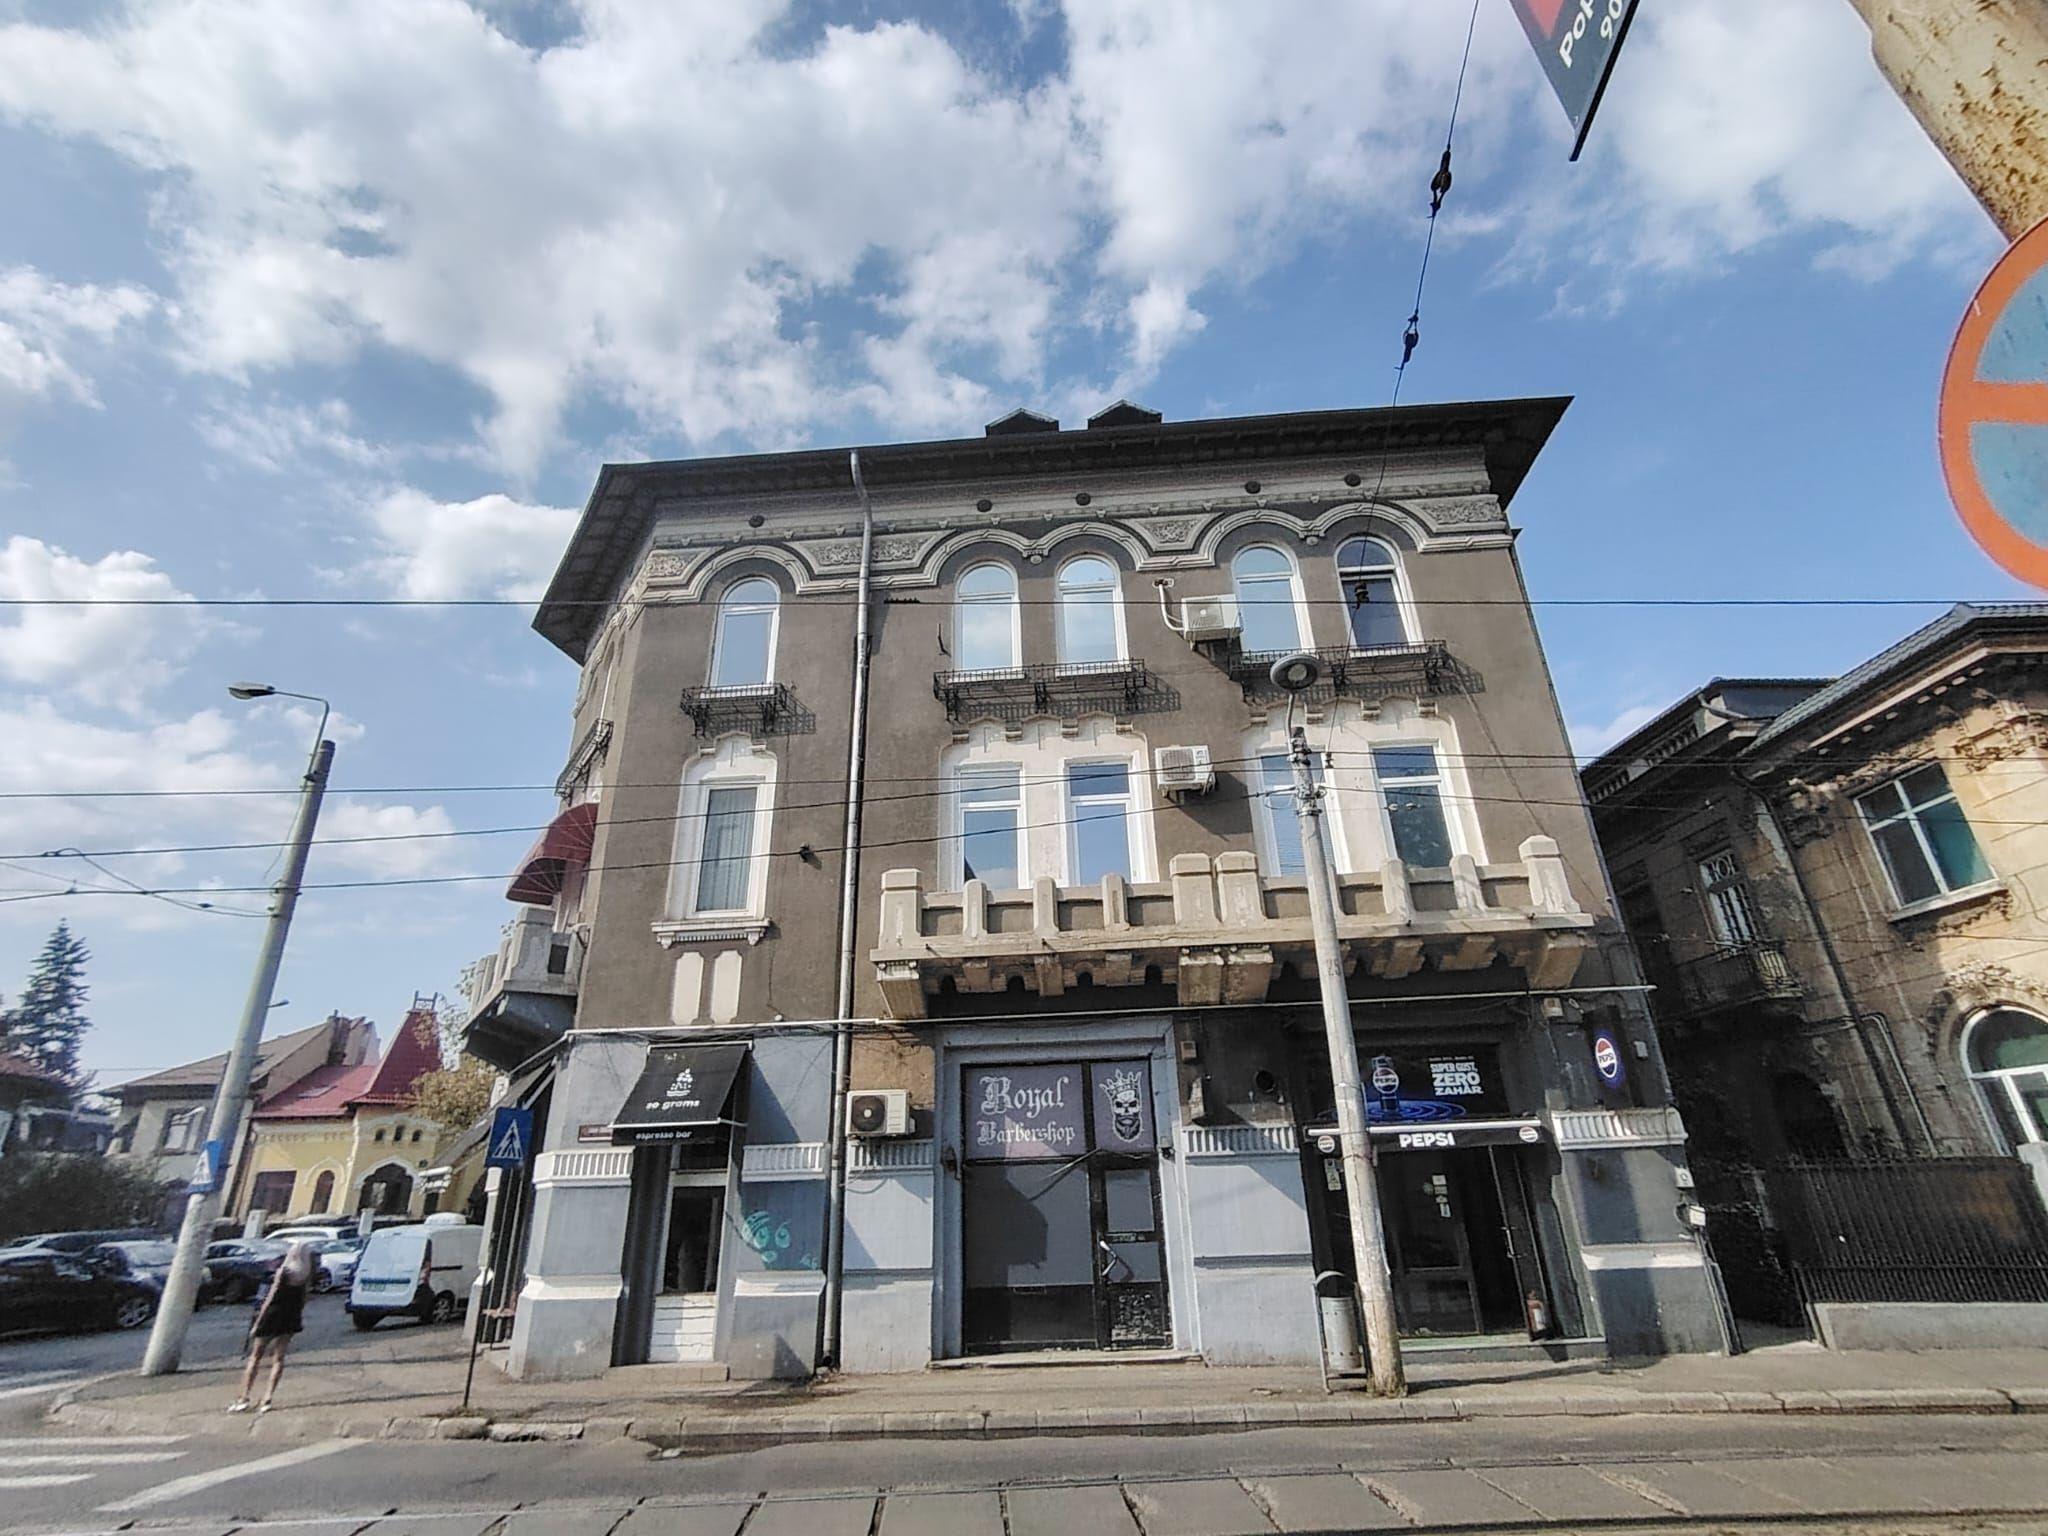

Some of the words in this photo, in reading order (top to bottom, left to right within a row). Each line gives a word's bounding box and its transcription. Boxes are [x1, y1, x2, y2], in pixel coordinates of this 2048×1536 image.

[1431, 1071, 1481, 1087] ZERO
[980, 1076, 1069, 1118] Royal
[661, 1100, 700, 1111] grams
[635, 1132, 674, 1141] espresso
[675, 1130, 692, 1138] bar
[976, 1121, 1076, 1146] Barbershop
[1398, 1132, 1457, 1148] PEPSI
